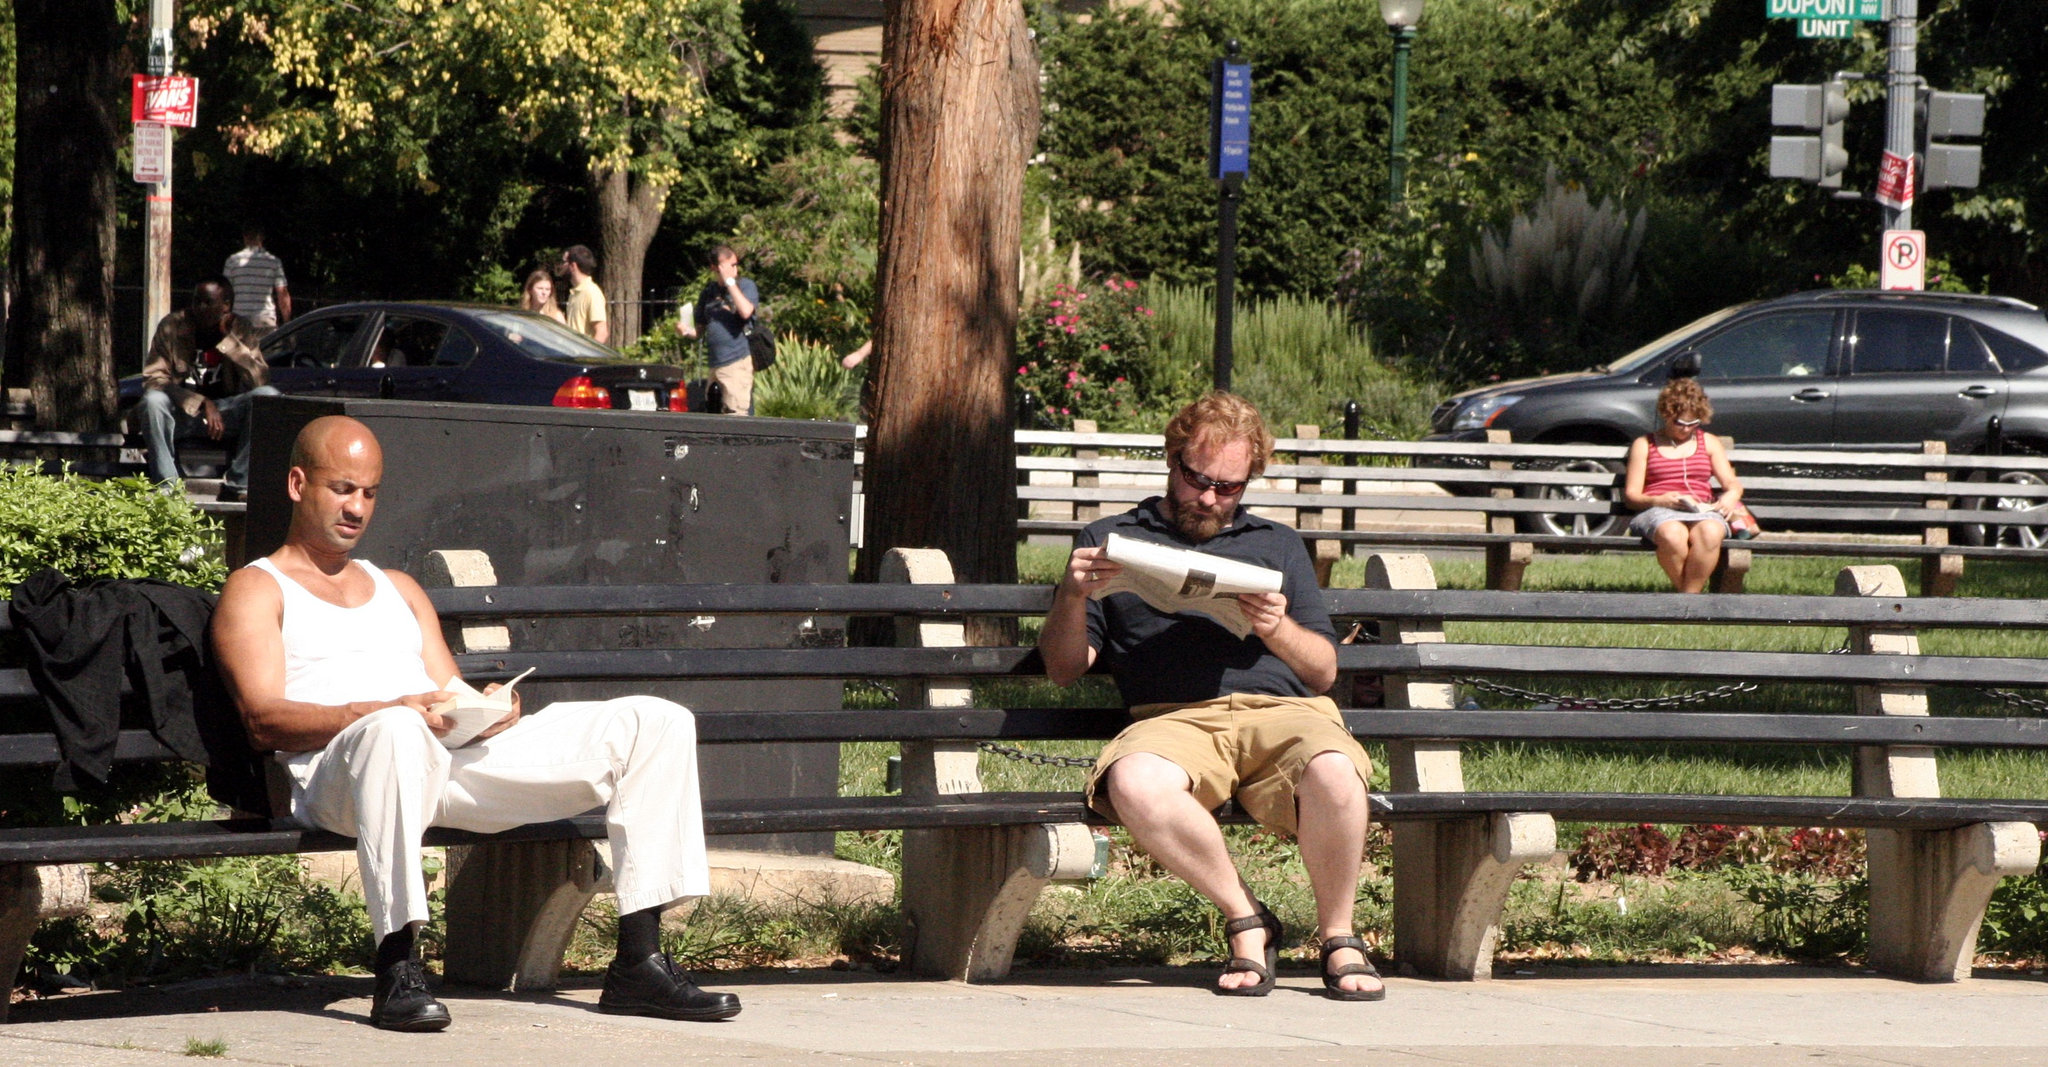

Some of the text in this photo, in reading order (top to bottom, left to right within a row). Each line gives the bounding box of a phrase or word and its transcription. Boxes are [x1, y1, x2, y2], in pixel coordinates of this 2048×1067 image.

[1771, 0, 1877, 15] DUPONT NW
[1801, 19, 1850, 37] UNIT
[1898, 243, 1913, 264] P
